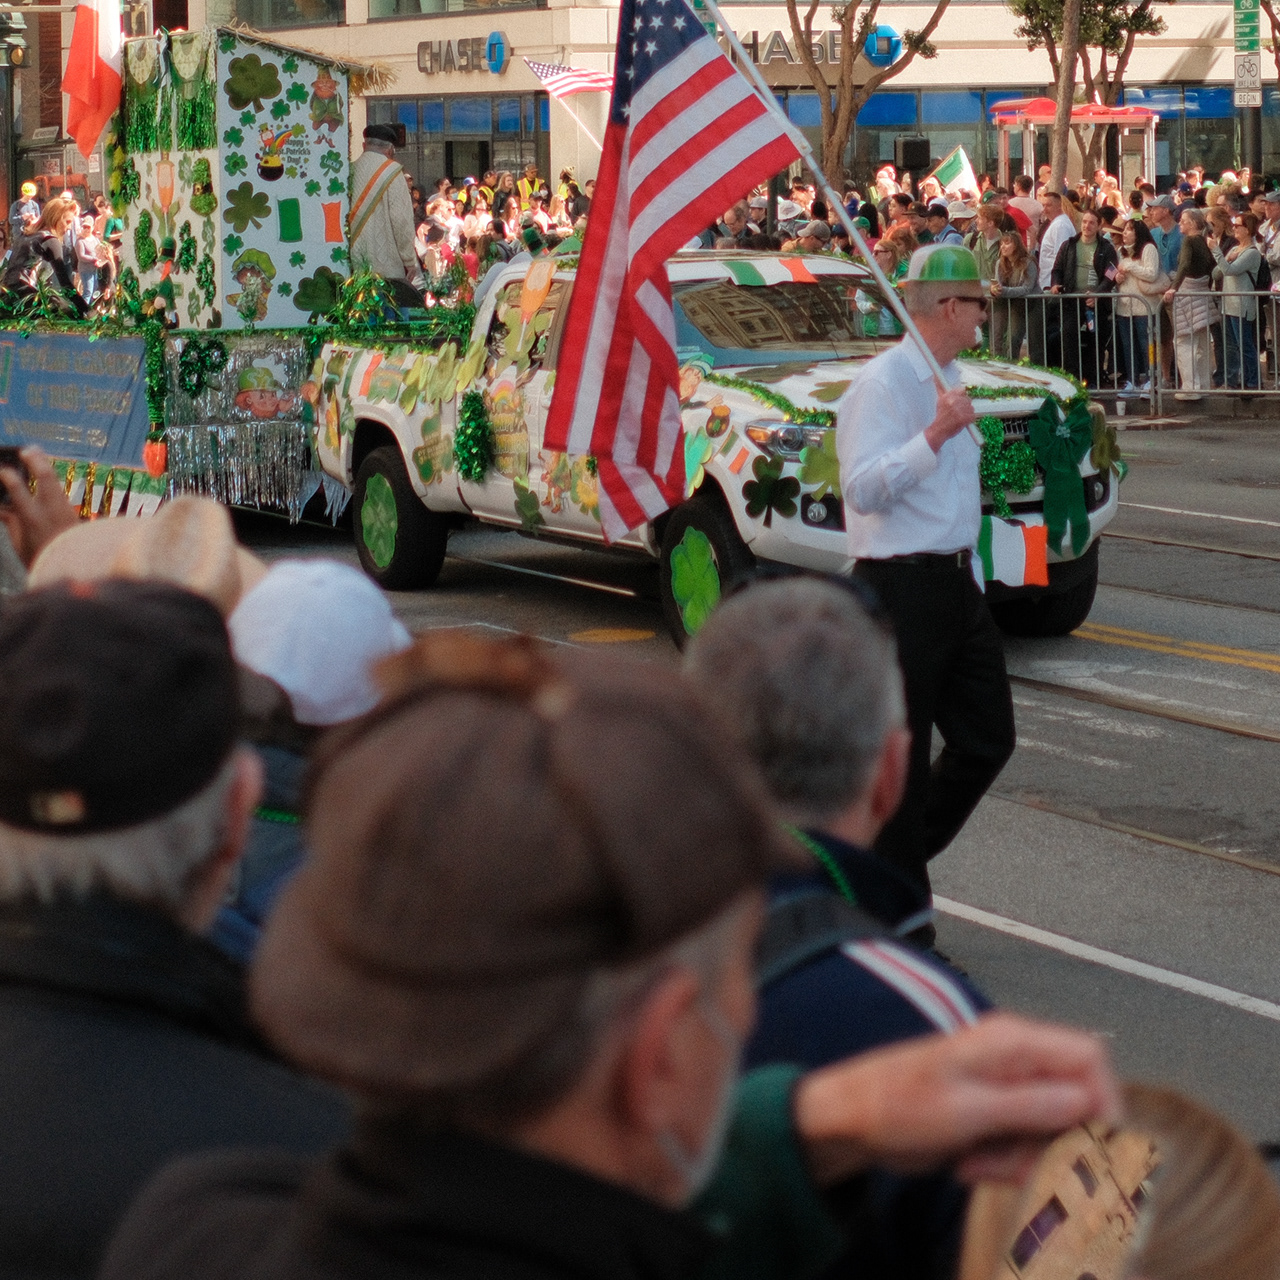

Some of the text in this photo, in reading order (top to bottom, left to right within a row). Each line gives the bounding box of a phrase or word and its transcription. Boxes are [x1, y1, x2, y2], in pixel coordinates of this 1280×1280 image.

[417, 37, 483, 73] CHASE
[718, 30, 843, 65] HASE
[1238, 94, 1257, 104] BEGIN
